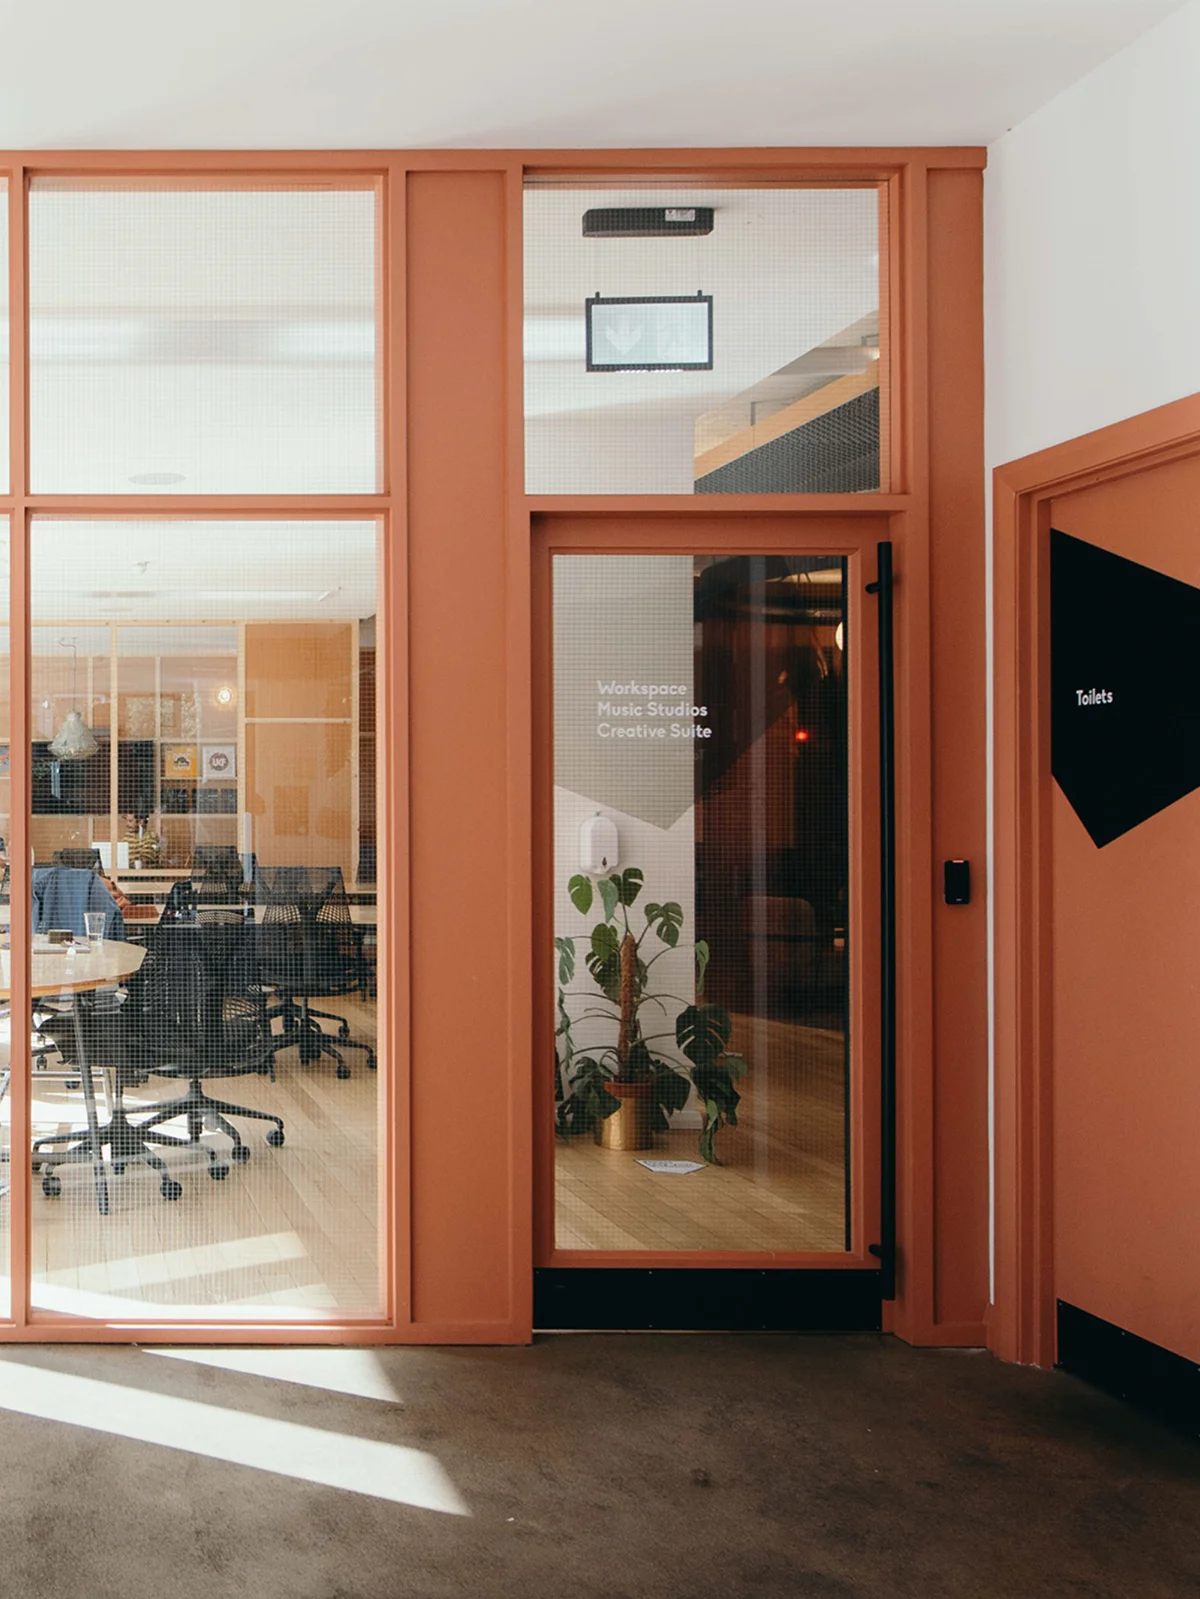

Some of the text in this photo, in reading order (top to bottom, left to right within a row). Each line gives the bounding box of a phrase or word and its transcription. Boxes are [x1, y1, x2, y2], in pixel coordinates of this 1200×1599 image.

[597, 680, 688, 700] Workspace
[1075, 688, 1114, 706] Toilets
[597, 702, 708, 717] Music Studios
[597, 722, 713, 738] Creative Suite
